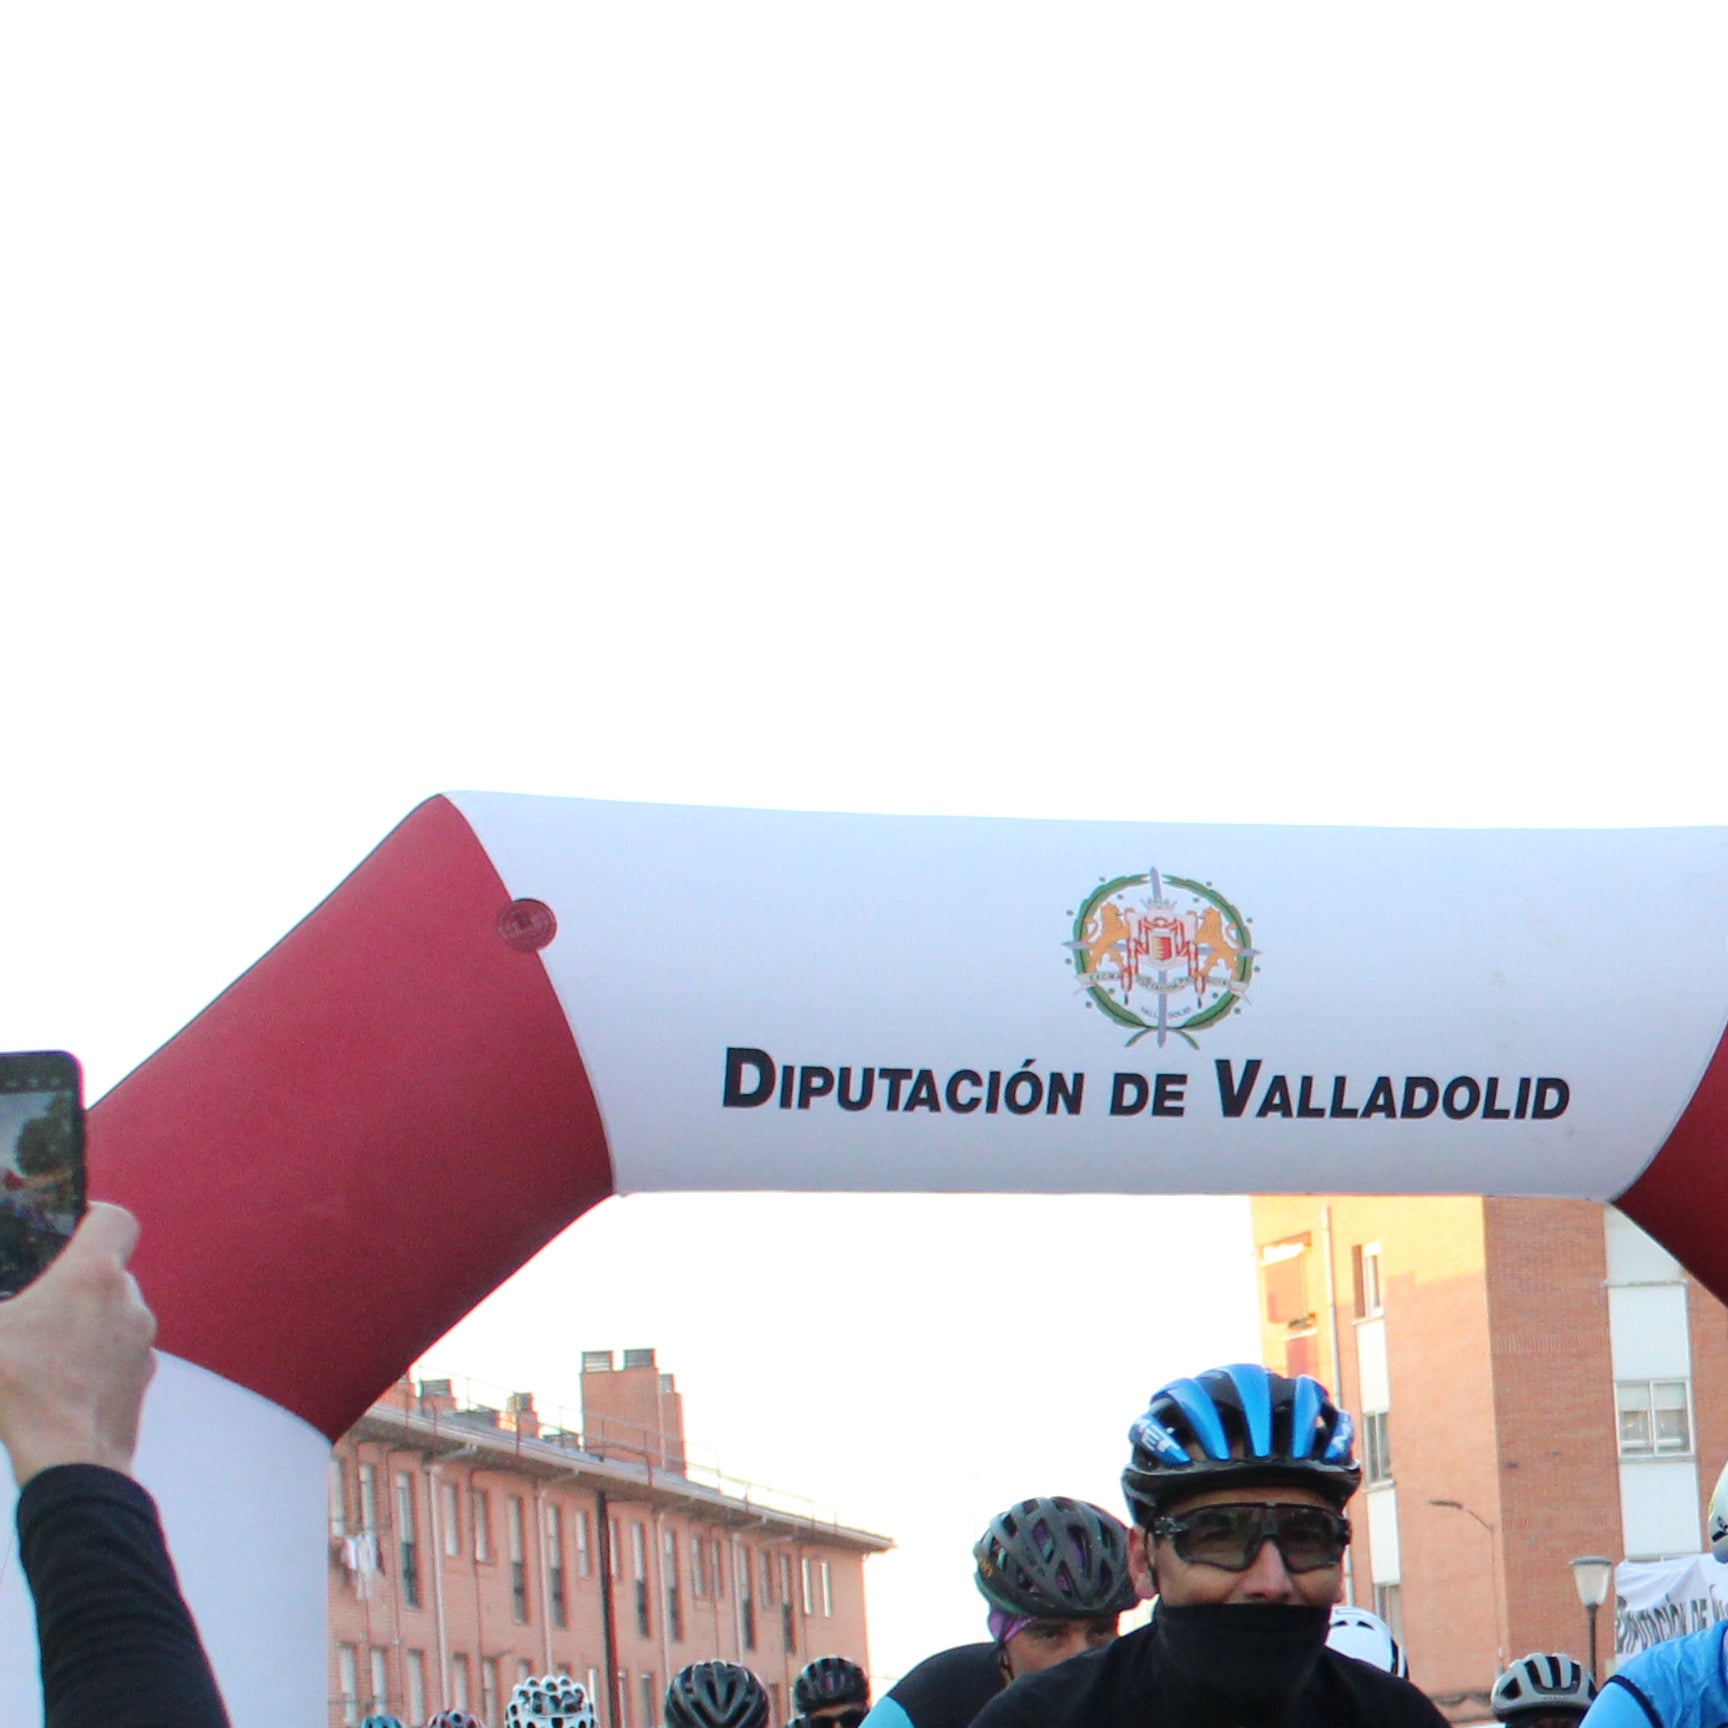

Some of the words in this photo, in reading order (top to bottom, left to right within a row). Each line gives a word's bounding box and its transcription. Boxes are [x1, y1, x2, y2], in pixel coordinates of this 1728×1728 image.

[723, 1047, 1084, 1116] DIPUTACIÓN
[1110, 1073, 1188, 1117] DE
[1215, 1059, 1572, 1121] VALLADOLID
